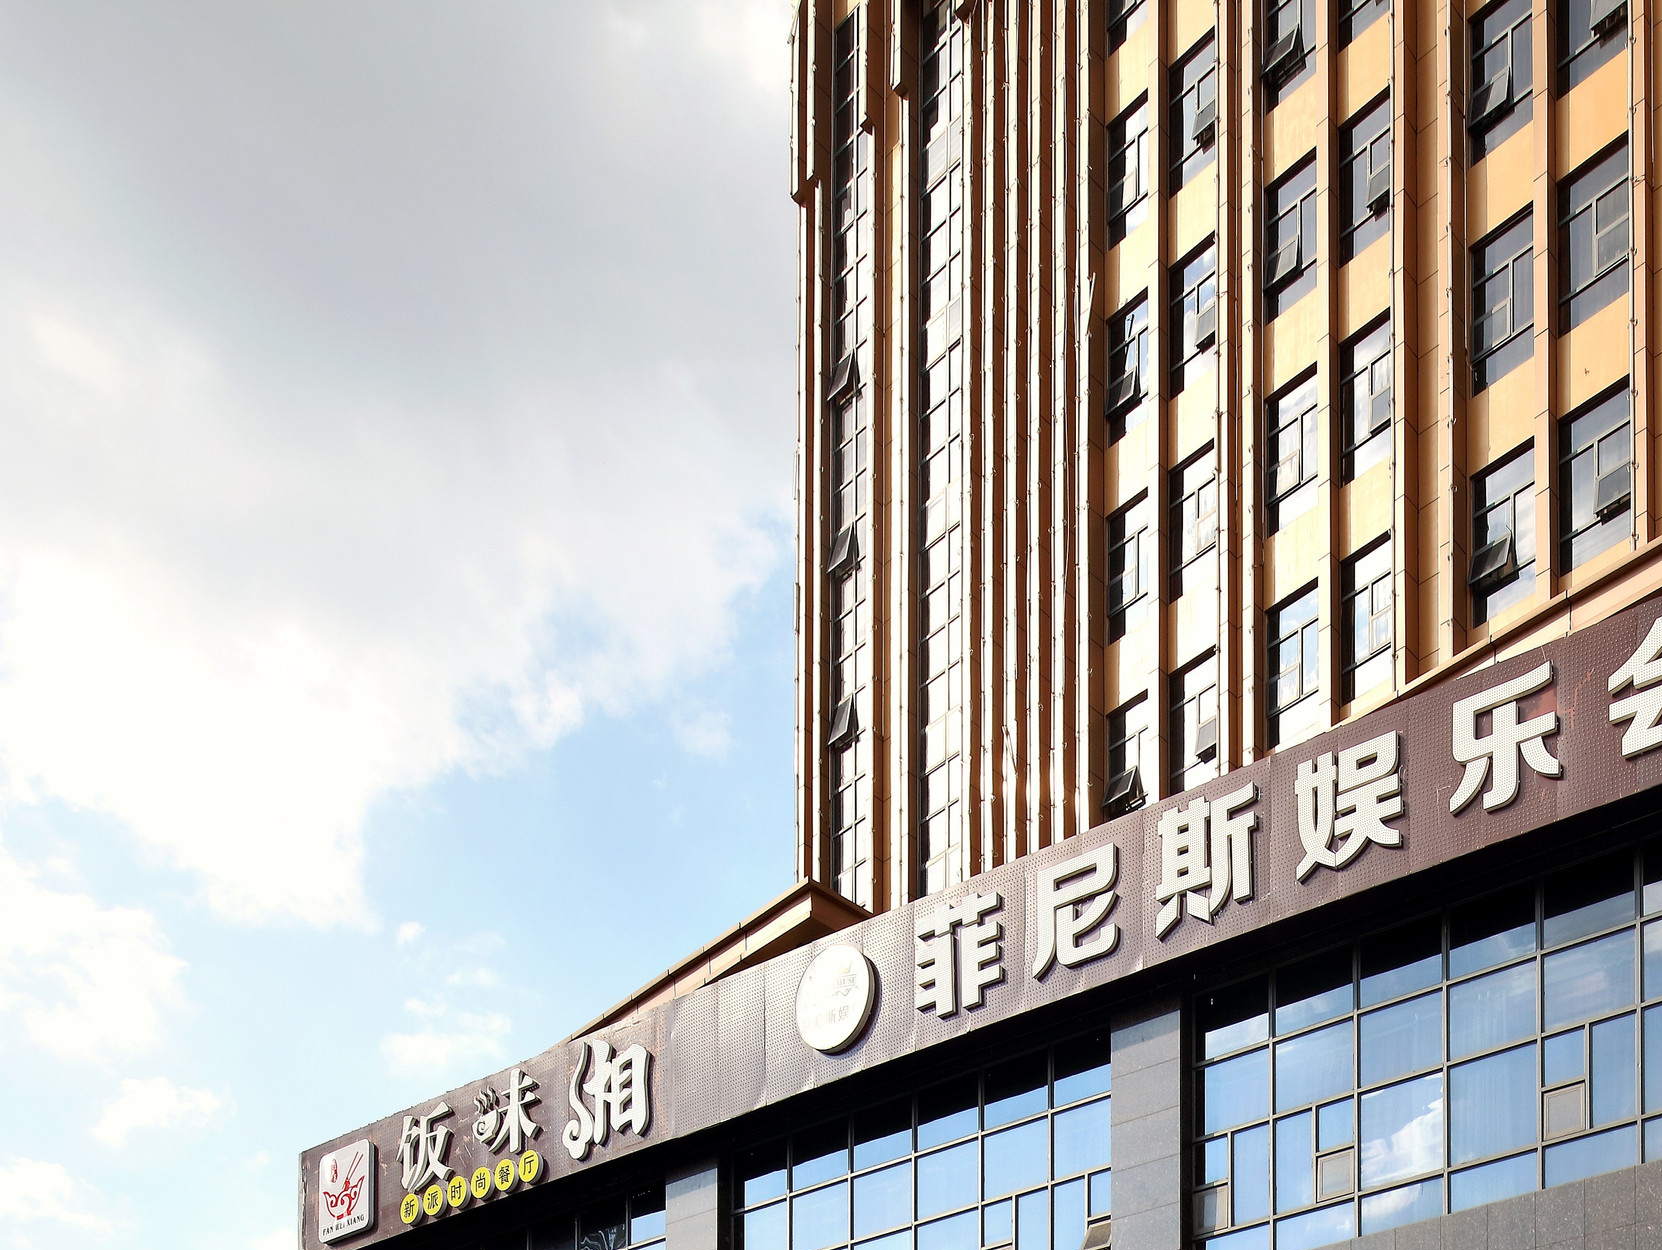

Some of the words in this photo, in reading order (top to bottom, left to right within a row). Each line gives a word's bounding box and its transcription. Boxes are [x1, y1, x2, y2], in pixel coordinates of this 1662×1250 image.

[396, 1038, 653, 1192] 饭味湘
[402, 1153, 537, 1219] 新派时尚餐厅
